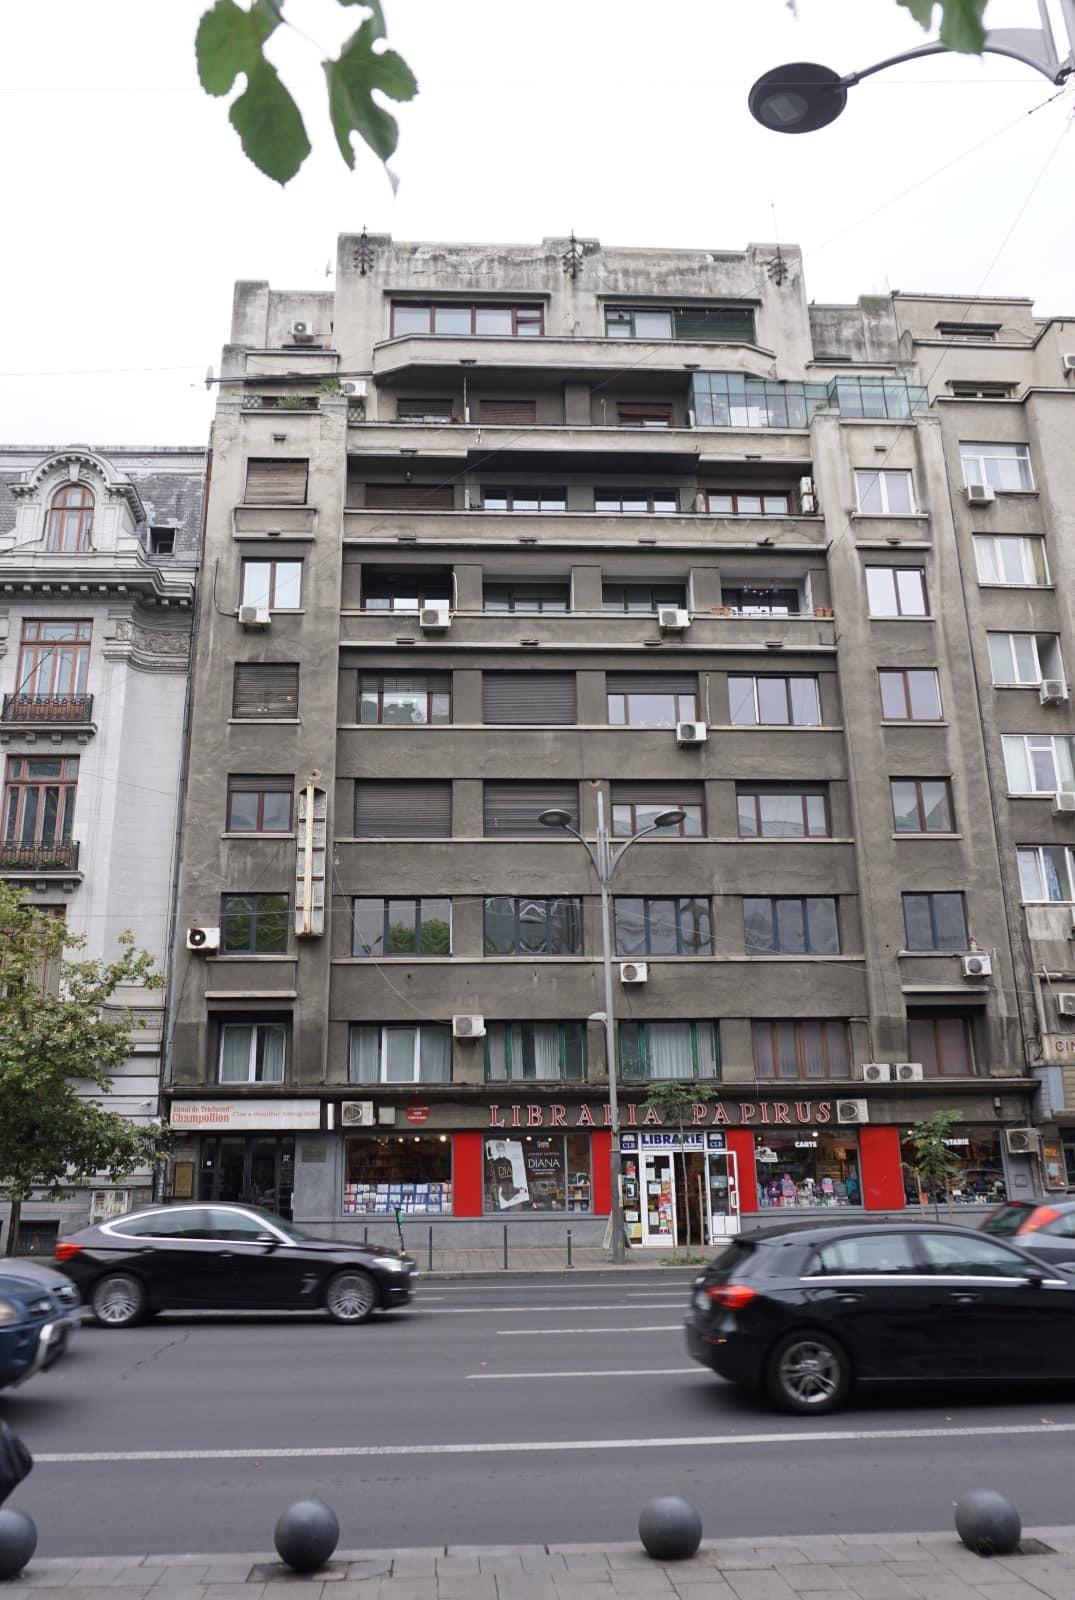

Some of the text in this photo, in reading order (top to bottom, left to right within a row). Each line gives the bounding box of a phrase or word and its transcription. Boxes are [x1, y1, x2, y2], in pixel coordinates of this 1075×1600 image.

[172, 1112, 230, 1124] Champollion
[691, 1101, 831, 1125] PAPIRUS
[527, 1157, 561, 1168] DIANA
